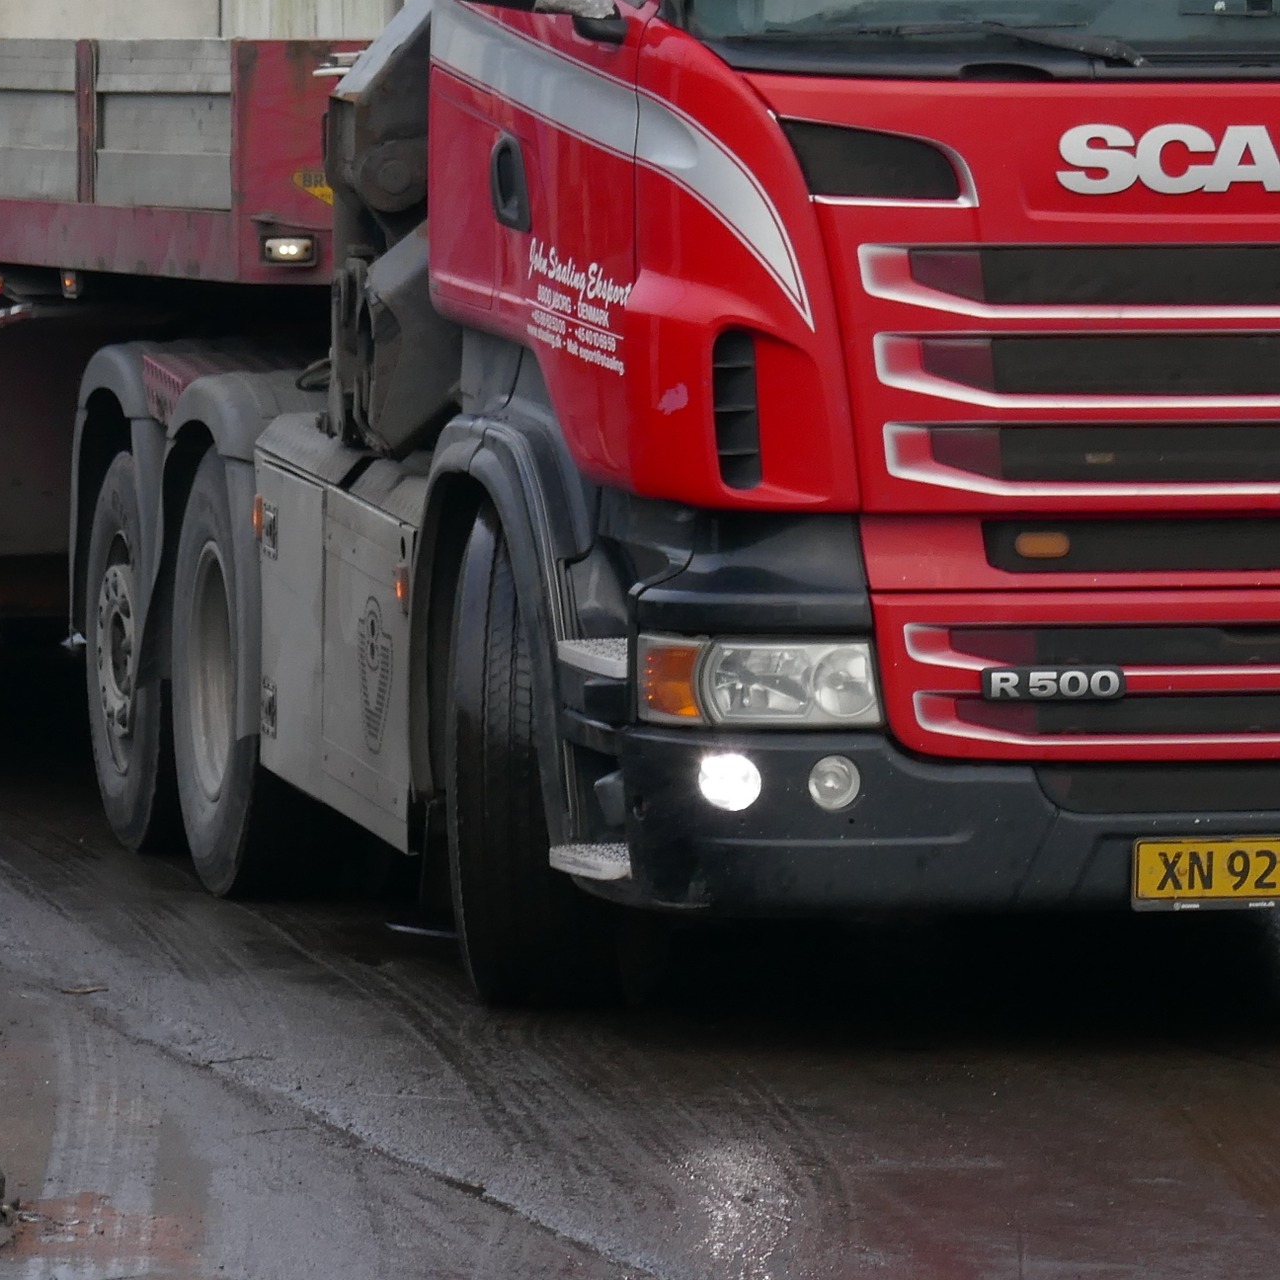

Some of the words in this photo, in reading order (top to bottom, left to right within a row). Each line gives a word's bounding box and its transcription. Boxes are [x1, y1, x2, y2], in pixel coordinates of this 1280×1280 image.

[528, 237, 548, 280] John
[990, 671, 1020, 697] R
[1028, 670, 1120, 696] 500
[1156, 851, 1214, 891] XN
[1226, 849, 1278, 891] 92
